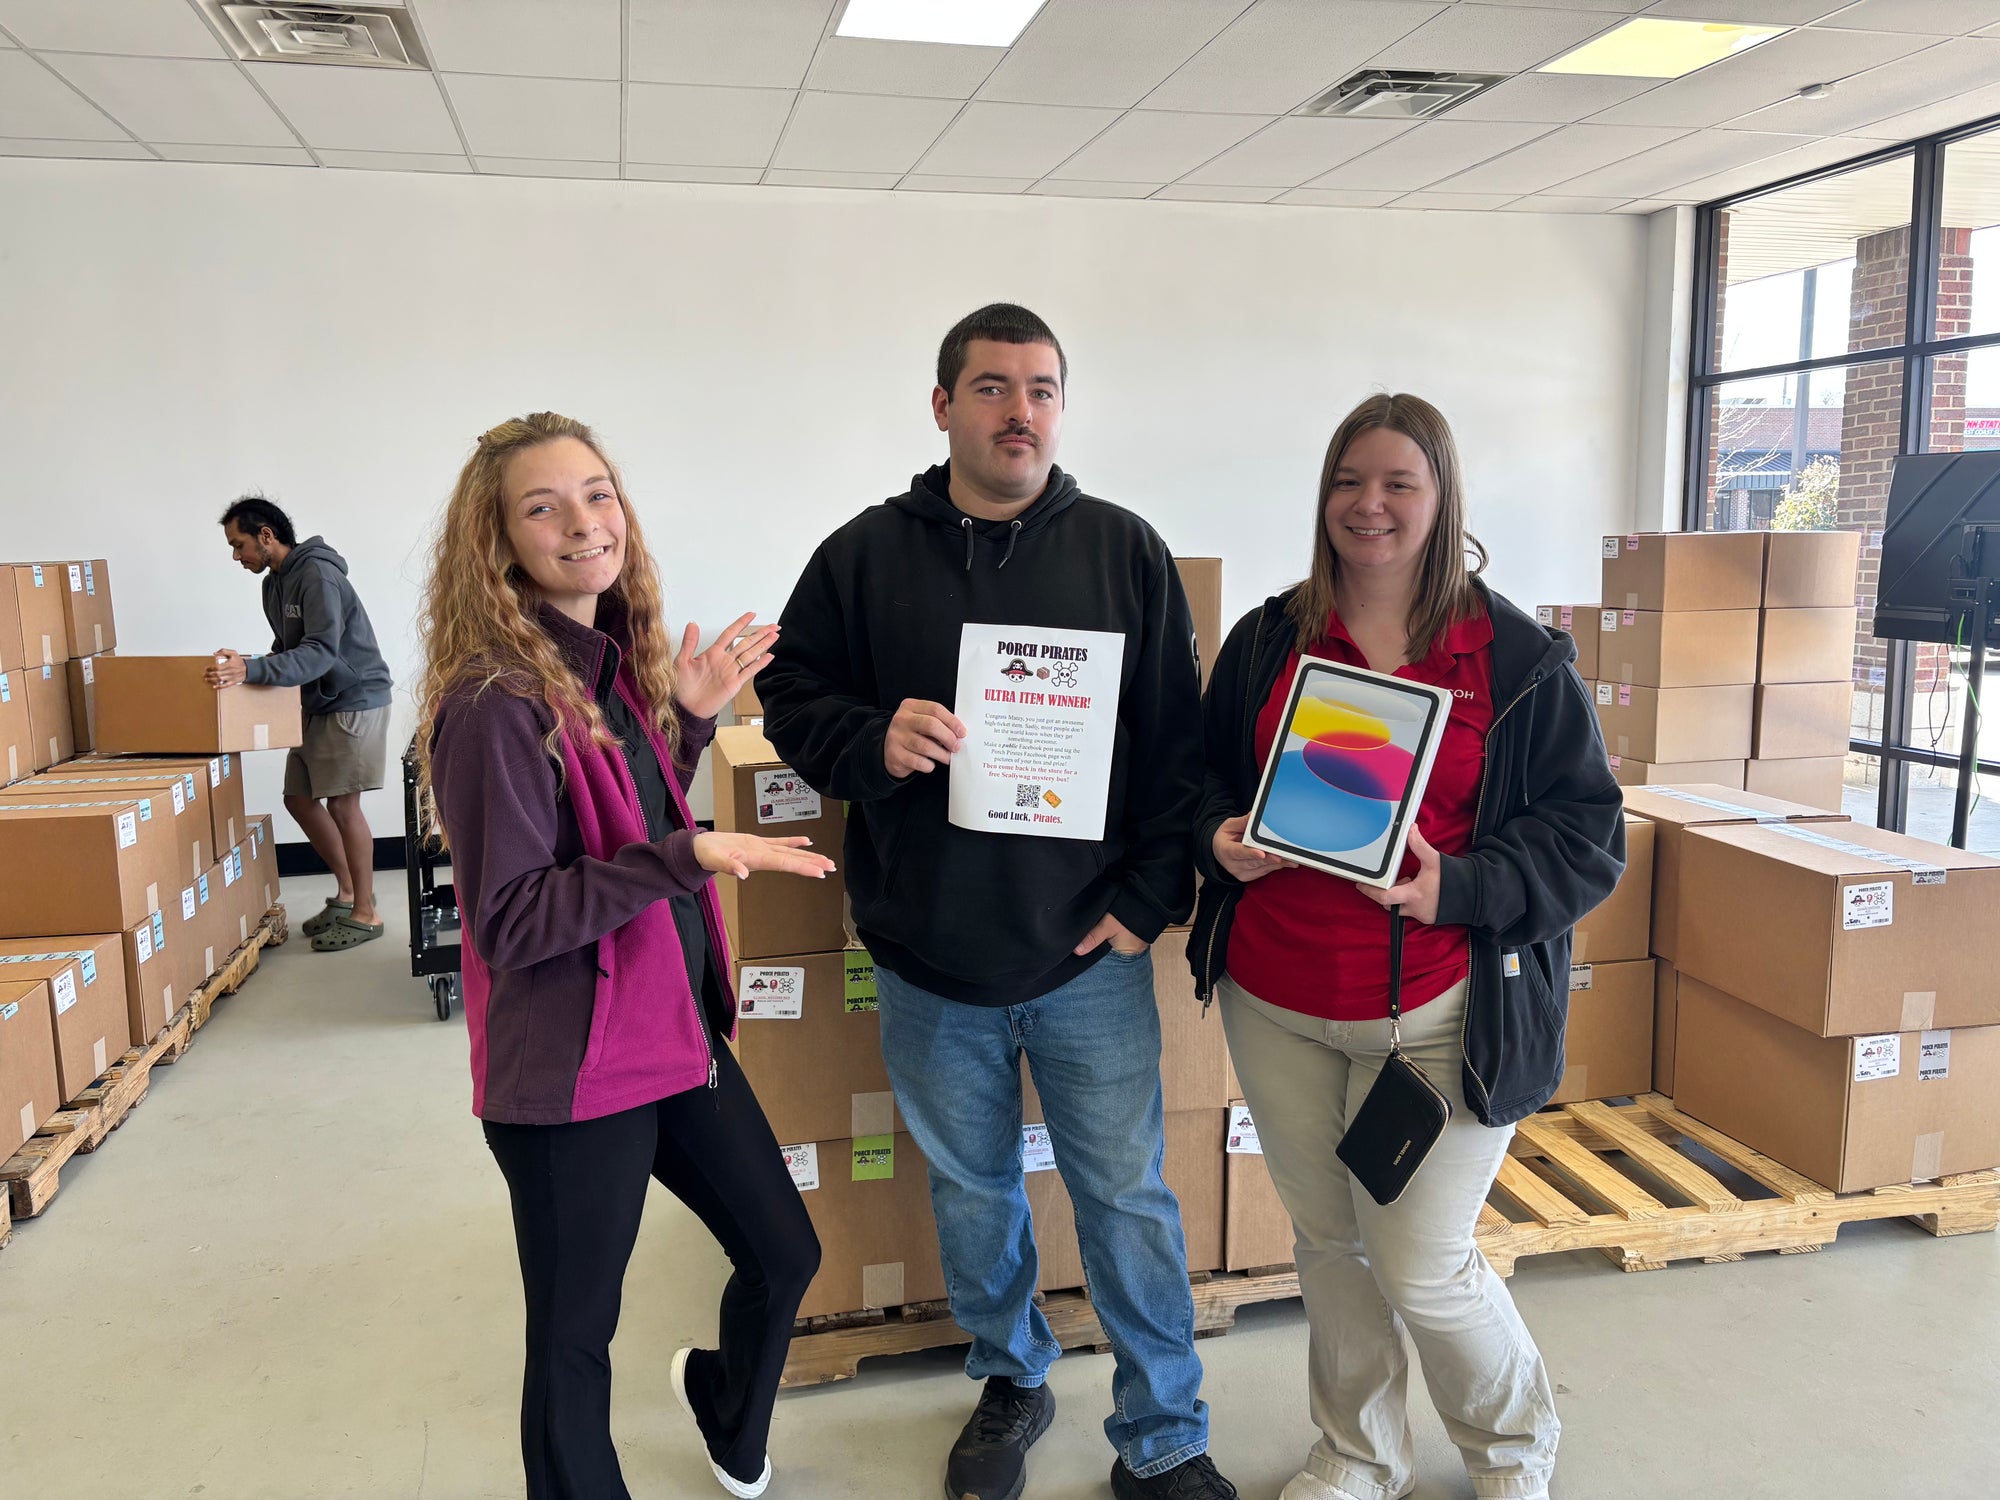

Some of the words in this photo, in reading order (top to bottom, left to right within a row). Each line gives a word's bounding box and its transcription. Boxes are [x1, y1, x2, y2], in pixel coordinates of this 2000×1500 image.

[1965, 420, 2000, 429] NN-STAT
[997, 641, 1038, 657] PORCH
[1040, 645, 1088, 662] PIRATES
[984, 689, 1015, 702] ULTRA
[1020, 692, 1045, 705] ITEM
[1048, 694, 1091, 709] WINNER!
[1008, 736, 1032, 744] something
[1001, 772, 1030, 780] Scallywag
[988, 810, 1008, 819] Good
[1010, 812, 1031, 822] Luck,
[1033, 814, 1063, 824] Pirates.
